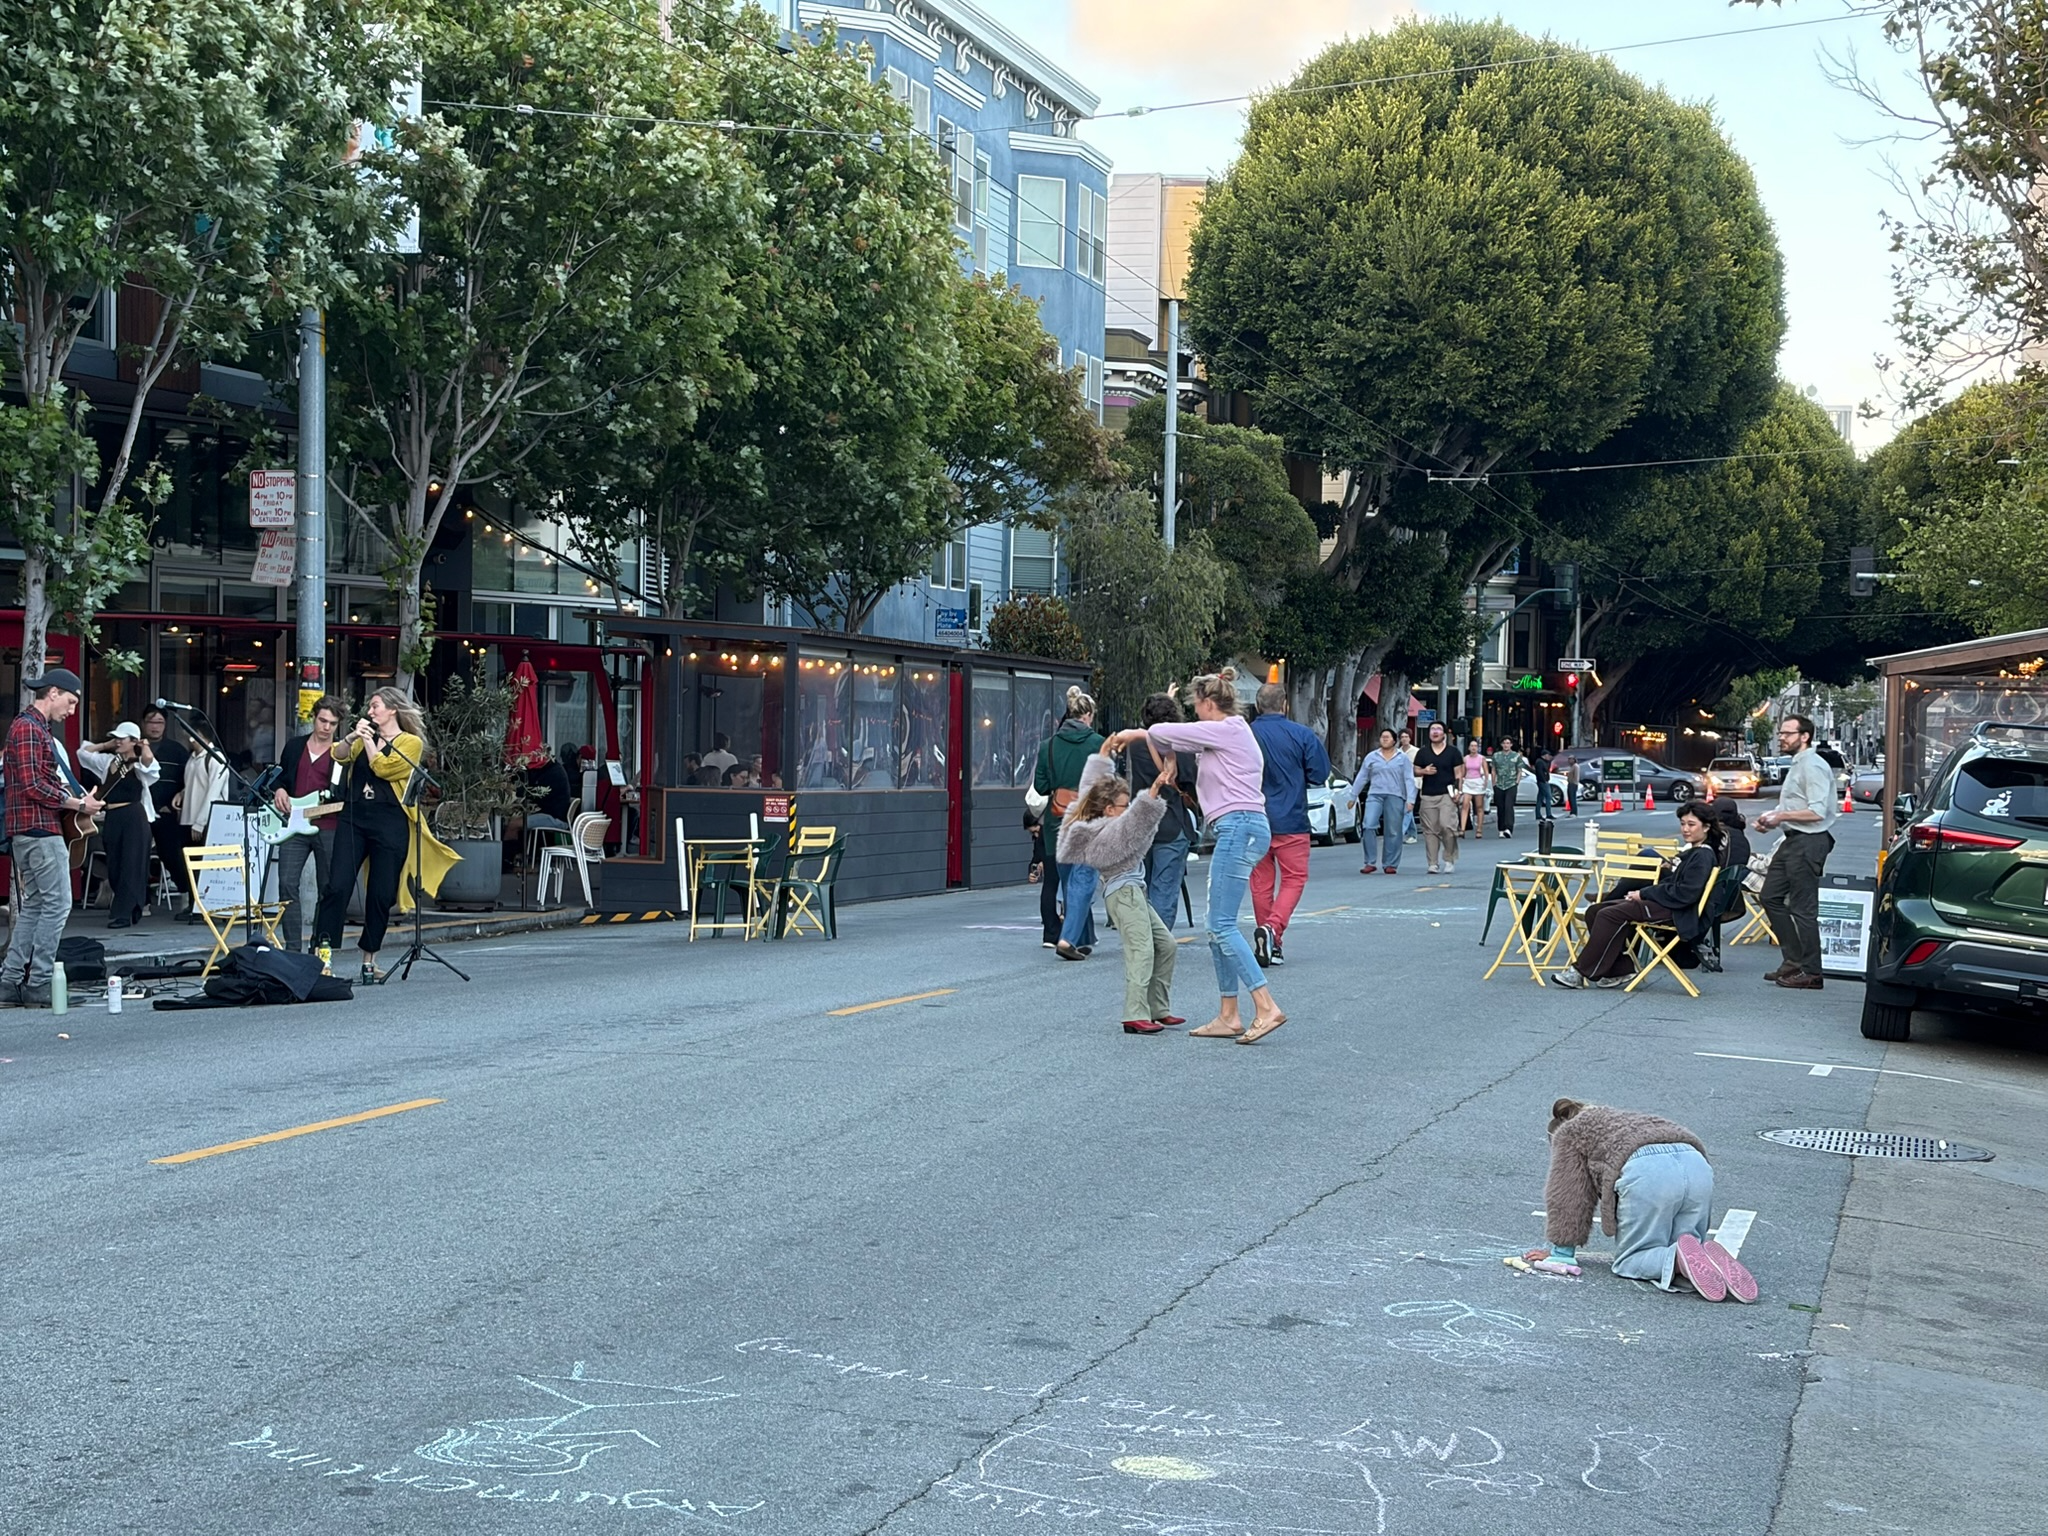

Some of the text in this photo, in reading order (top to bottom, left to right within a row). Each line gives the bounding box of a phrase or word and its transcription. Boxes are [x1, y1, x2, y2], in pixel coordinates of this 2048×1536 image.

[251, 472, 295, 487] NO STOPPING
[254, 491, 267, 500] 4PM
[262, 531, 276, 547] NO
[256, 563, 268, 572] TUE
